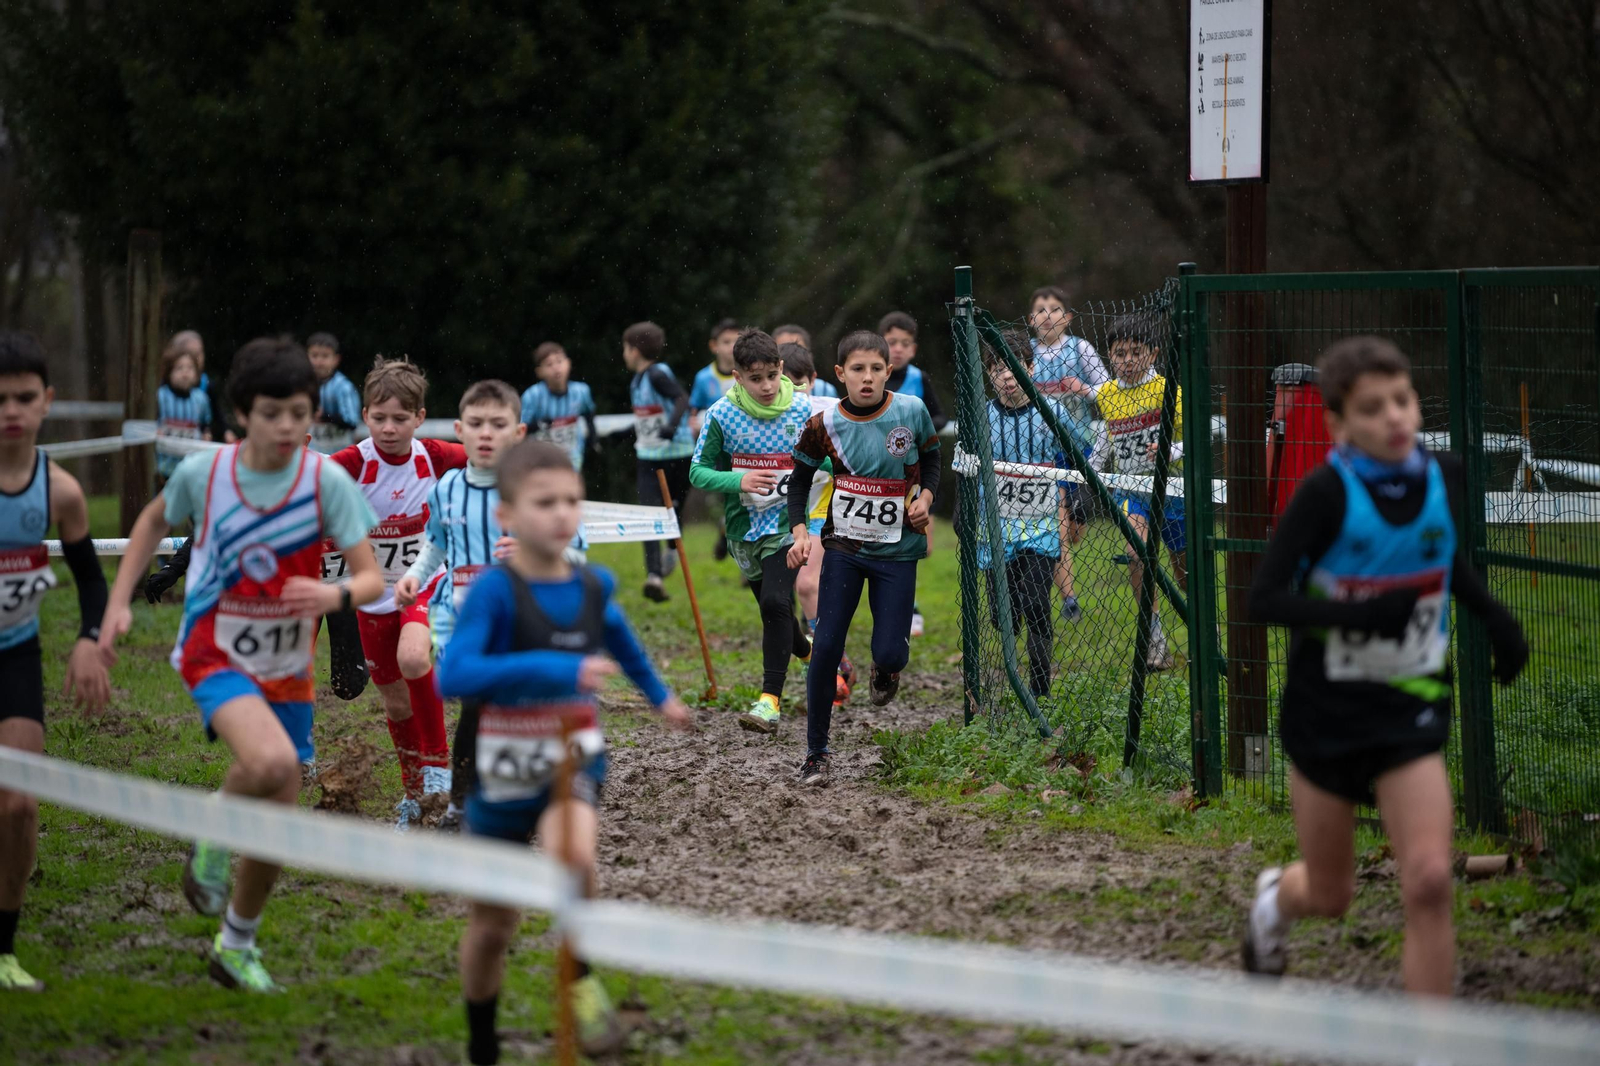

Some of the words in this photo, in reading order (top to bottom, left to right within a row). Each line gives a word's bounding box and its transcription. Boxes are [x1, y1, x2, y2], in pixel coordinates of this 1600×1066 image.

[733, 457, 779, 468] RIBADAVIA
[780, 460, 795, 468] 202
[836, 479, 883, 494] RIBADAVIA
[999, 481, 1051, 504] 457
[839, 495, 898, 526] 748
[368, 526, 401, 536] DAVIA
[371, 539, 420, 569] 75
[232, 621, 301, 656] 611
